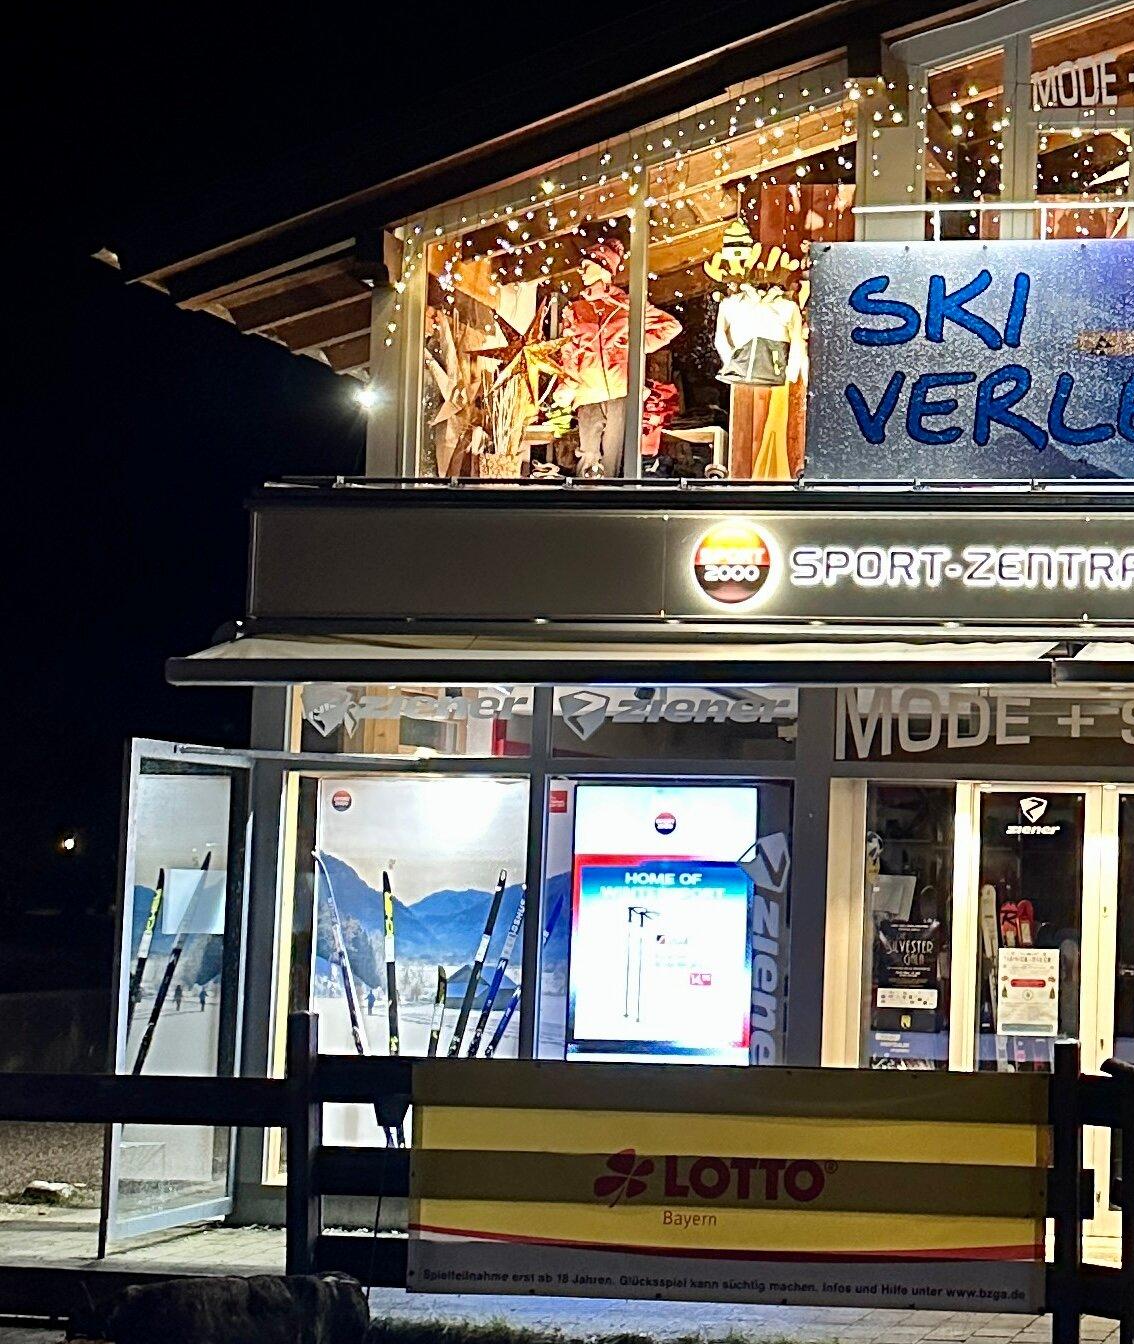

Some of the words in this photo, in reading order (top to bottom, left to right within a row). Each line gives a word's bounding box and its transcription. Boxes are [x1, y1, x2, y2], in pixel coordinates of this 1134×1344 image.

[1031, 54, 1118, 107] MODE
[848, 268, 1031, 351] SKI
[703, 564, 761, 582] 2000
[611, 698, 791, 724] ziener
[834, 687, 1032, 760] MODE
[624, 871, 676, 886] HOME
[679, 872, 702, 885] OF
[750, 894, 780, 1066] ziene
[662, 1210, 718, 1230] Bayern
[423, 1268, 509, 1283] Spielteilnahme
[512, 1271, 535, 1283] erst
[537, 1272, 552, 1284] ab
[557, 1273, 570, 1284] 18
[689, 1277, 720, 1290] kann
[822, 1281, 851, 1295] Infos
[855, 1282, 878, 1296] und
[881, 1283, 908, 1297] Hilfe
[911, 1285, 942, 1298] unter
[945, 1286, 1027, 1302] www.bzga.de
